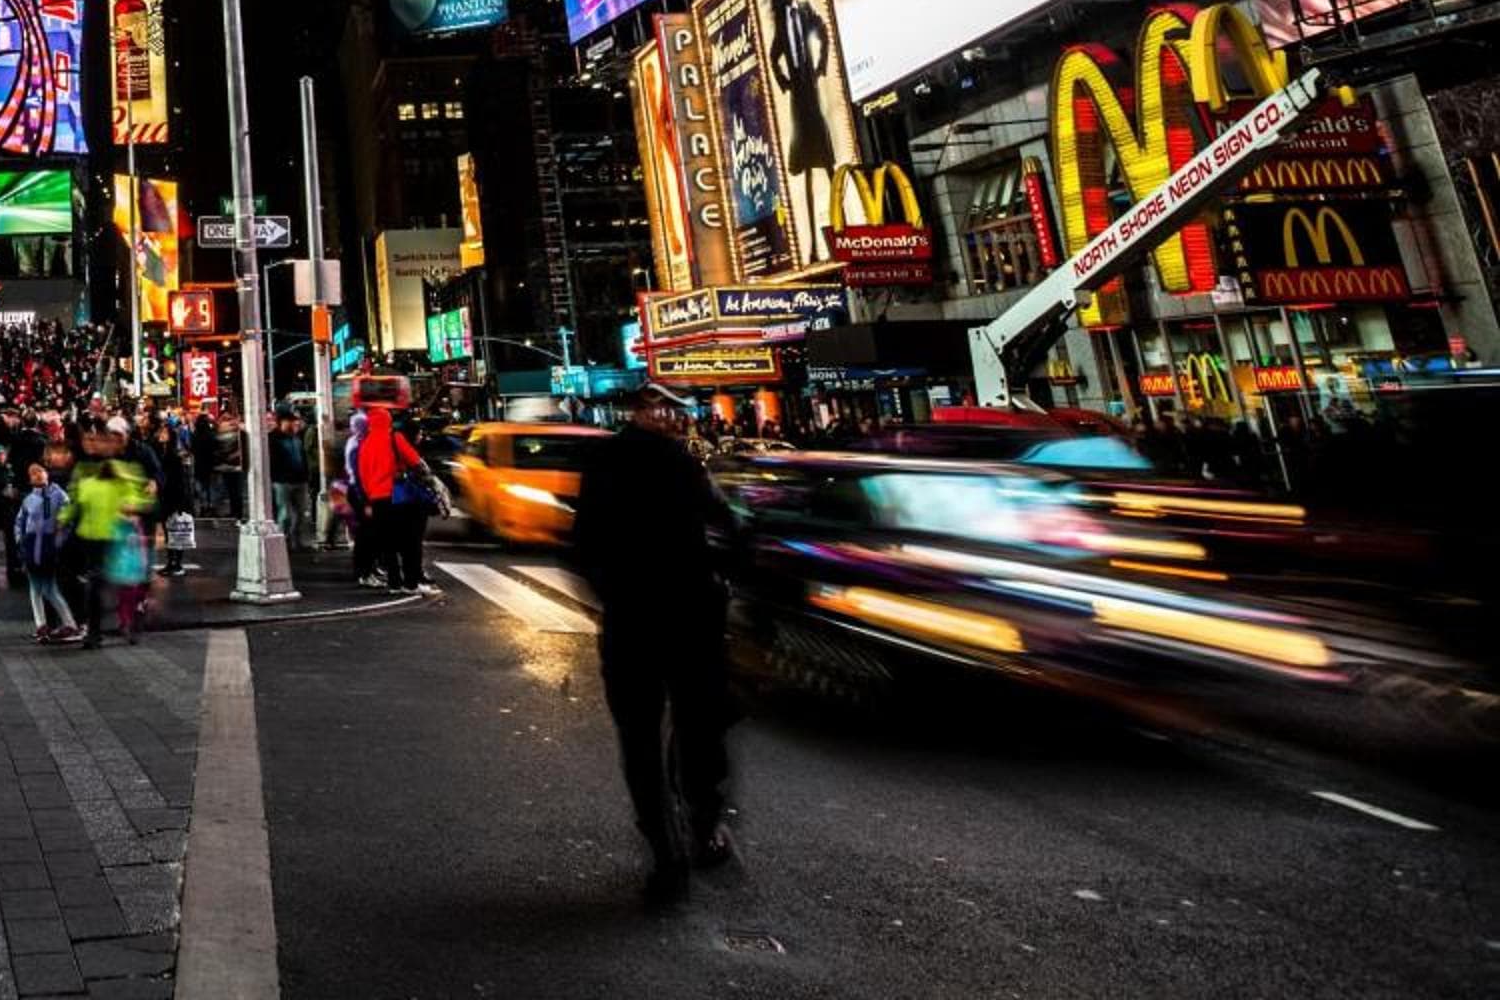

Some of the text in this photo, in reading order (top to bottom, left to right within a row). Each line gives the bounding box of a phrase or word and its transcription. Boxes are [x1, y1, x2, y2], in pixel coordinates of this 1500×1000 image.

[675, 29, 720, 227] PALACE
[207, 225, 233, 237] ONE
[1073, 102, 1285, 278] NORTH SHORE NEON SIGN CO.
[836, 235, 928, 249] McDonald's
